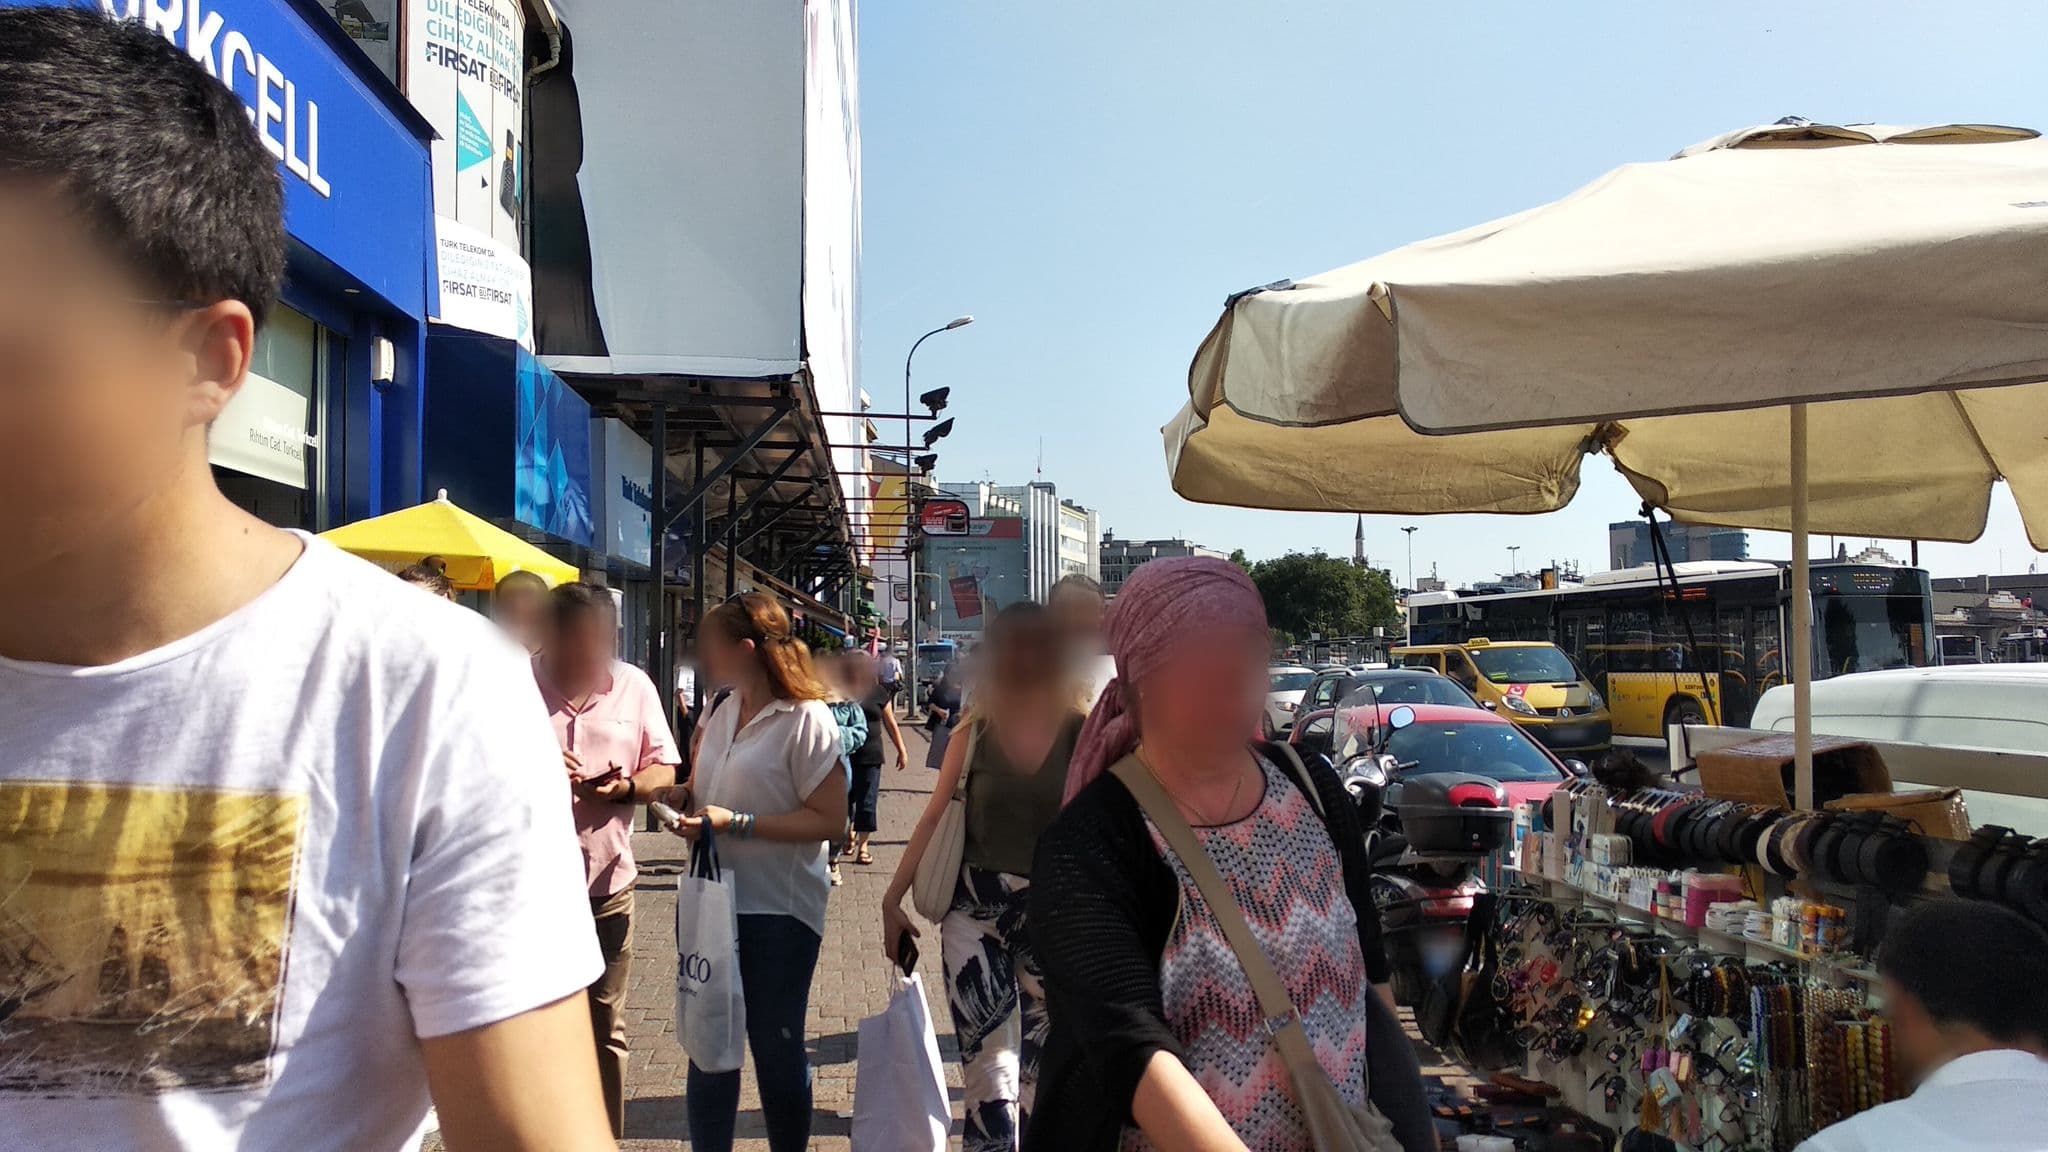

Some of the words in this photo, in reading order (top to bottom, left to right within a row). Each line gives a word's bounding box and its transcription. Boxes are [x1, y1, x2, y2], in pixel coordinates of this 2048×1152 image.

[464, 0, 510, 31] ELEKOM'DA
[426, 19, 473, 51] CİHAZ
[426, 41, 487, 82] FIRSAT
[100, 0, 331, 198] RKCELL
[443, 280, 477, 298] FIRSAT
[487, 288, 512, 305] FIRSAT
